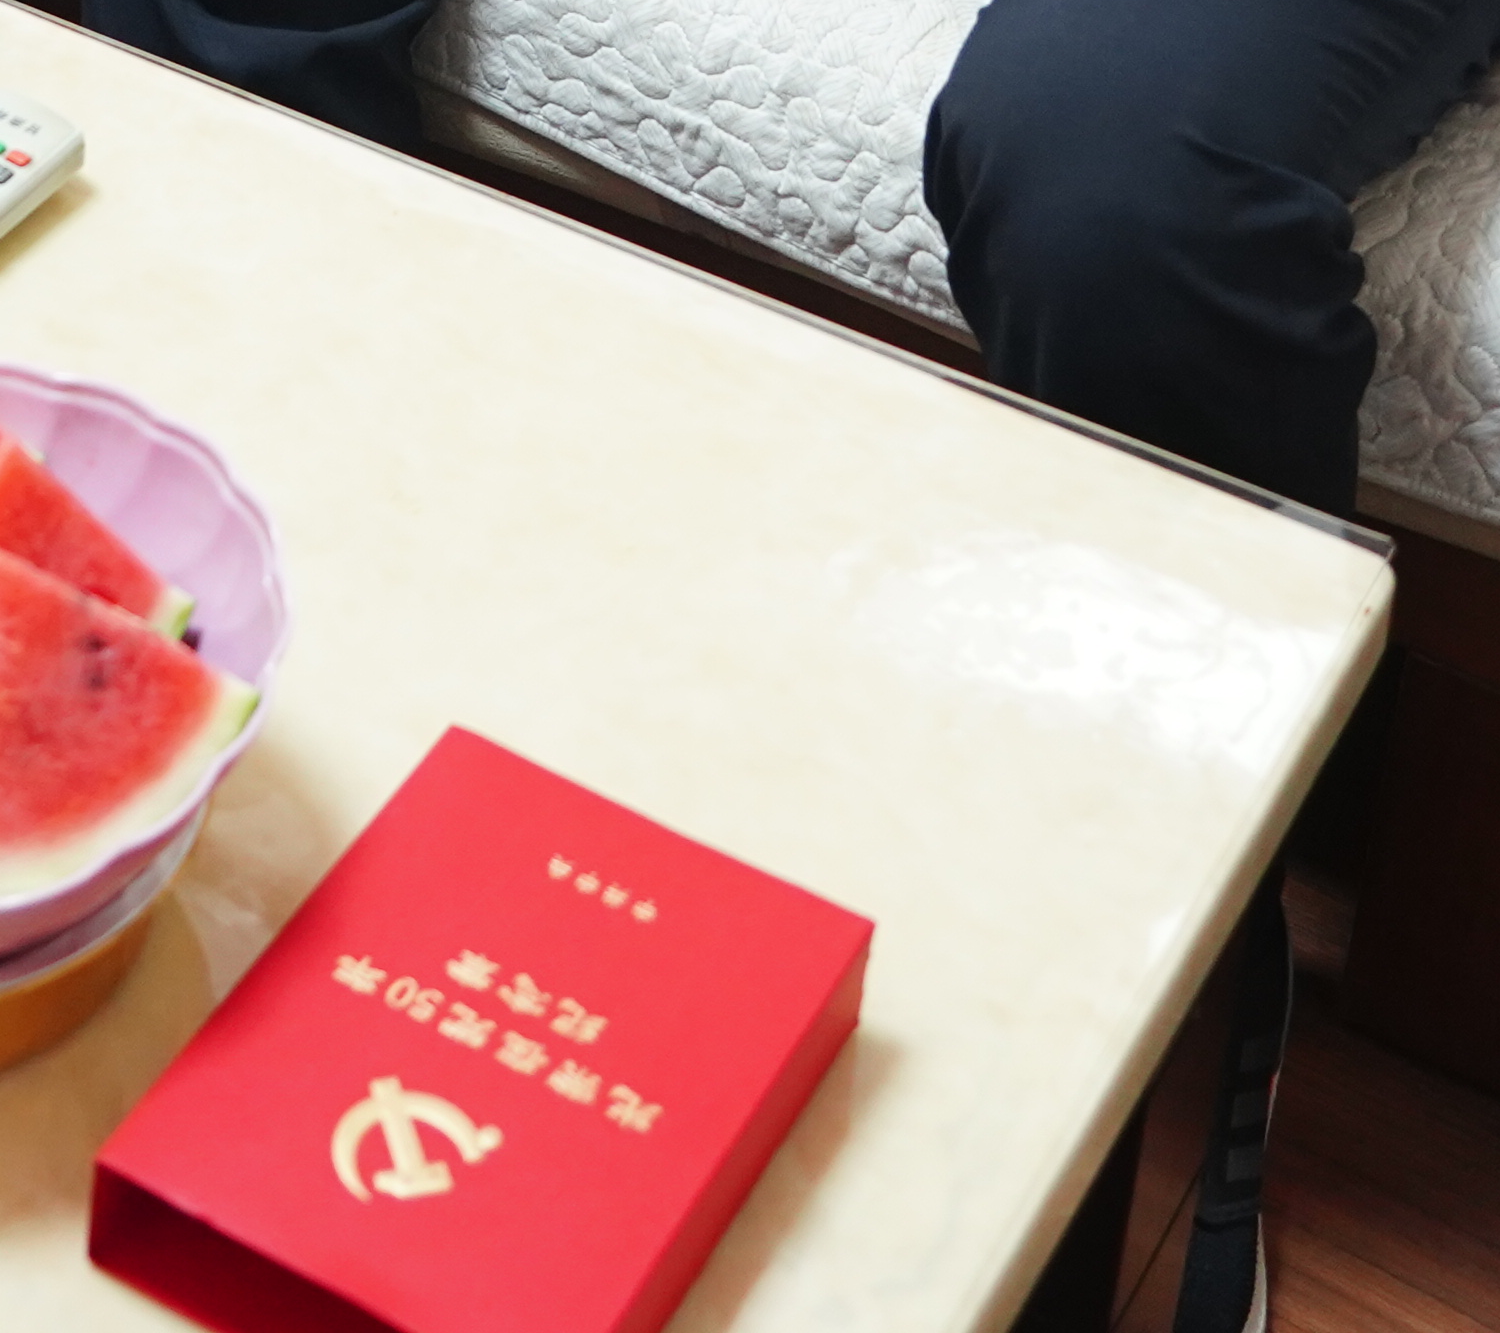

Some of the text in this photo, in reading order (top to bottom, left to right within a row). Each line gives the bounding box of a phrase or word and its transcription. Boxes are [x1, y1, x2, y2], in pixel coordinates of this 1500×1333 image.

[331, 954, 663, 1133] 光荣在党50年
[446, 949, 608, 1044] 纪念章
